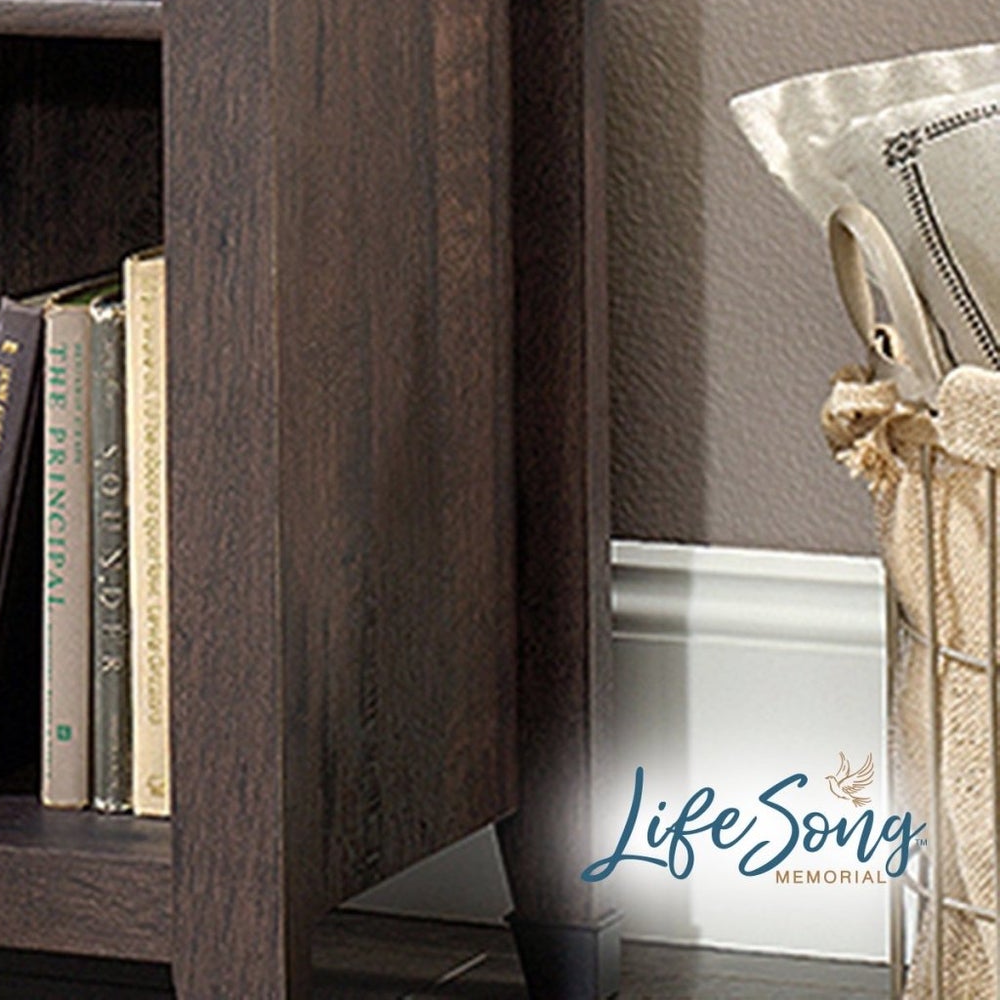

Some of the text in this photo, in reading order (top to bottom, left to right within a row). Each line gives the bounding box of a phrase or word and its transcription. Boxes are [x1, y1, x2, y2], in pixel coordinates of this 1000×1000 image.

[48, 344, 67, 611] THE PRINCIPAL
[94, 444, 122, 672] SOUNDER
